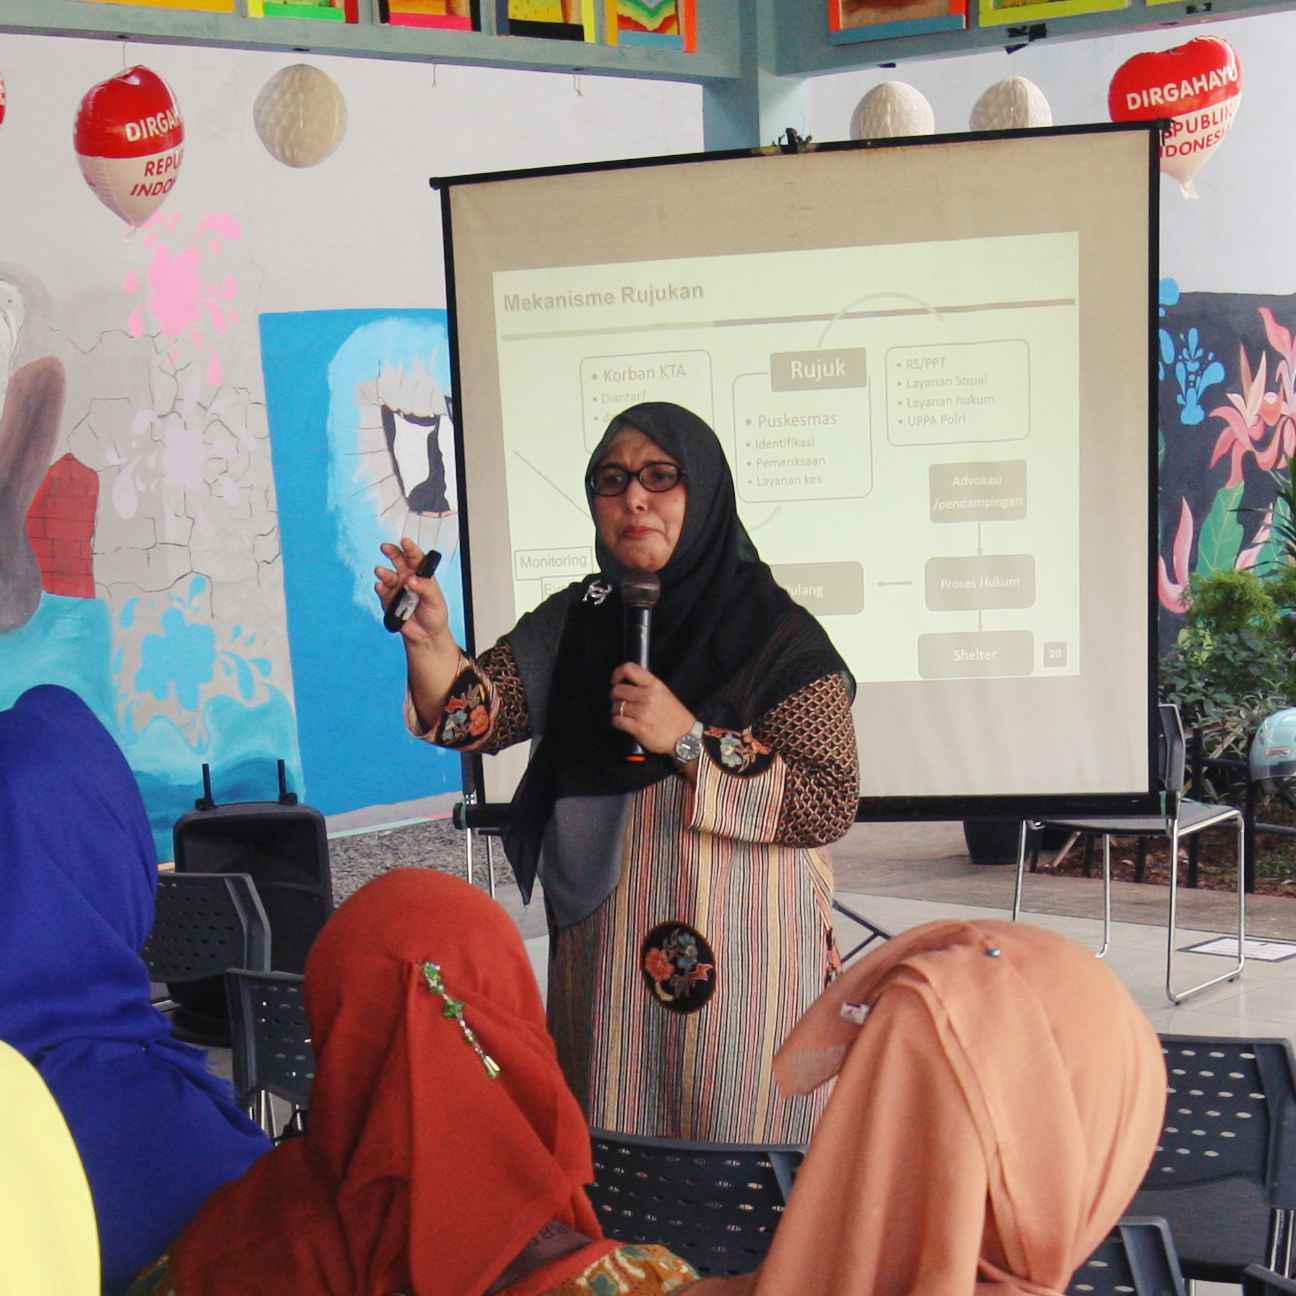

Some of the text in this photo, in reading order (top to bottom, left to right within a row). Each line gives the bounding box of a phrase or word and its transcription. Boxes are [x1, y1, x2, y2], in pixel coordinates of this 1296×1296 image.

[1126, 65, 1239, 111] DIRGAHAYU
[503, 282, 704, 312] Mekanisme Rujukan
[603, 363, 687, 383] Korban KTA
[791, 357, 846, 381] Rujuk
[906, 377, 952, 390] Layanan
[906, 396, 952, 410] Layanan
[757, 412, 838, 429] Puskesmas
[755, 435, 816, 450] Identifikasi
[756, 455, 826, 469] Pemeriksaan
[756, 475, 803, 489] Layanan
[520, 554, 588, 569] Monitoring
[784, 583, 824, 599] ulang
[952, 647, 999, 662] Shelter
